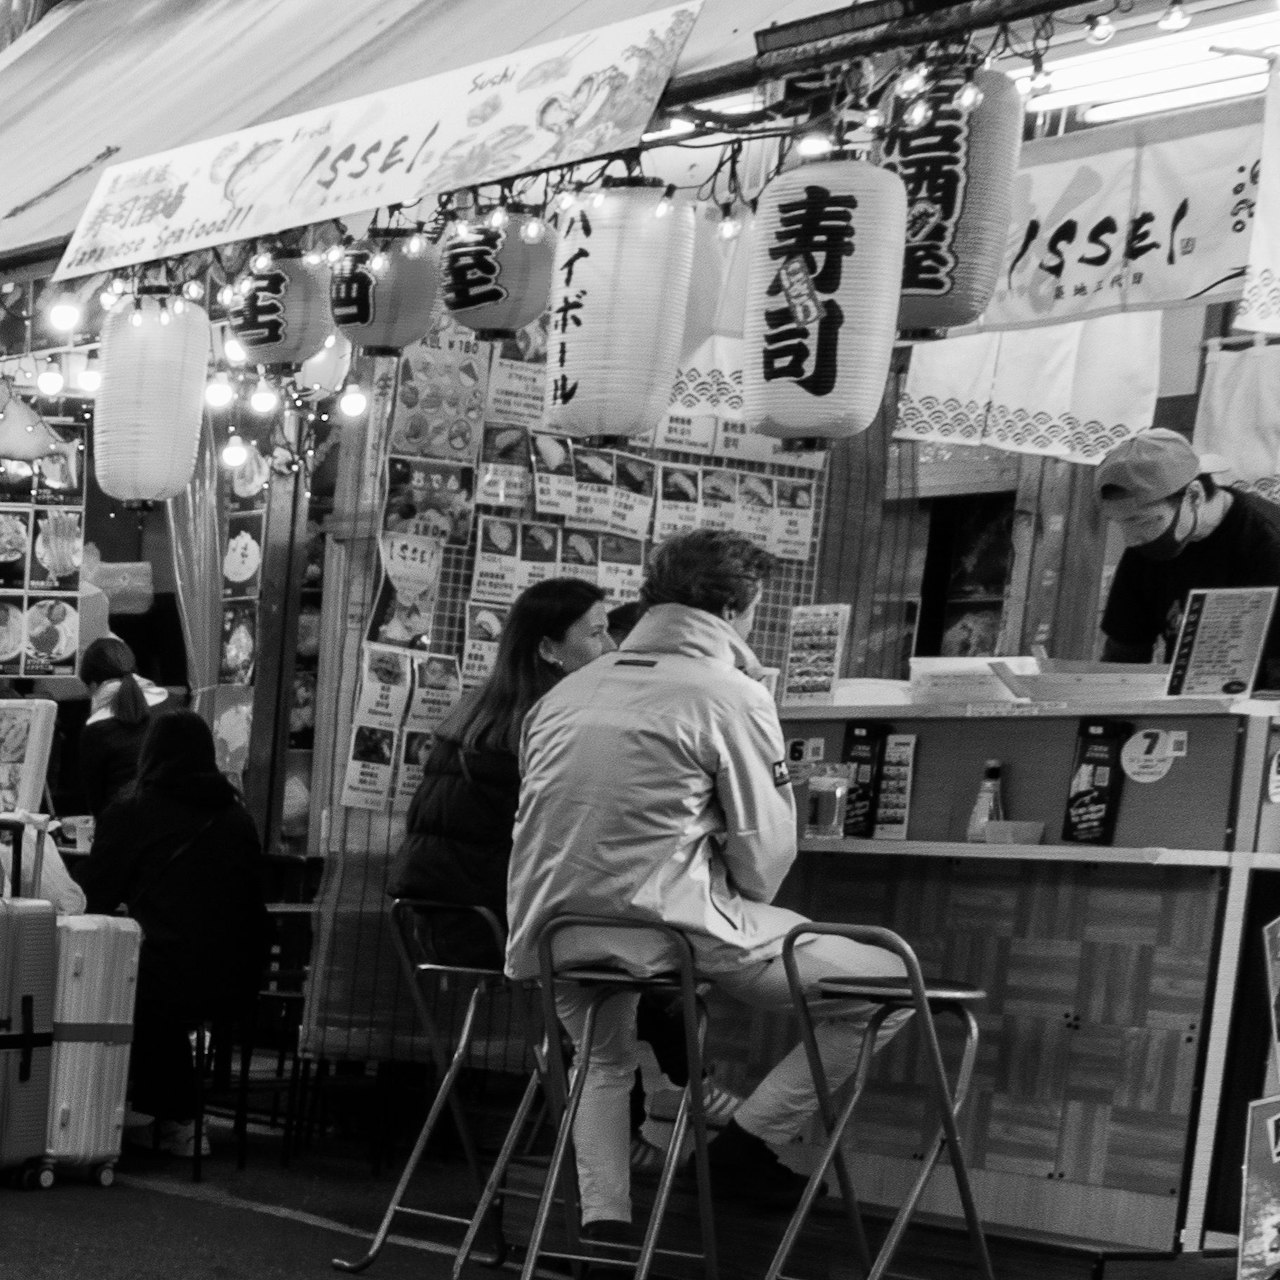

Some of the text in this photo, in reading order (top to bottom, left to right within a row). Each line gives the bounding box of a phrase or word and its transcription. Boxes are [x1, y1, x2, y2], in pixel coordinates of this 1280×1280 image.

[467, 63, 517, 95] Sushi
[289, 119, 441, 206] ISSEI
[1007, 197, 1190, 291] ISSEI
[762, 185, 858, 396] 寿司
[550, 209, 590, 406] ハイボール
[420, 337, 442, 351] ALL
[410, 469, 461, 491] おでん
[789, 740, 805, 762] 6
[1142, 731, 1161, 756] 7
